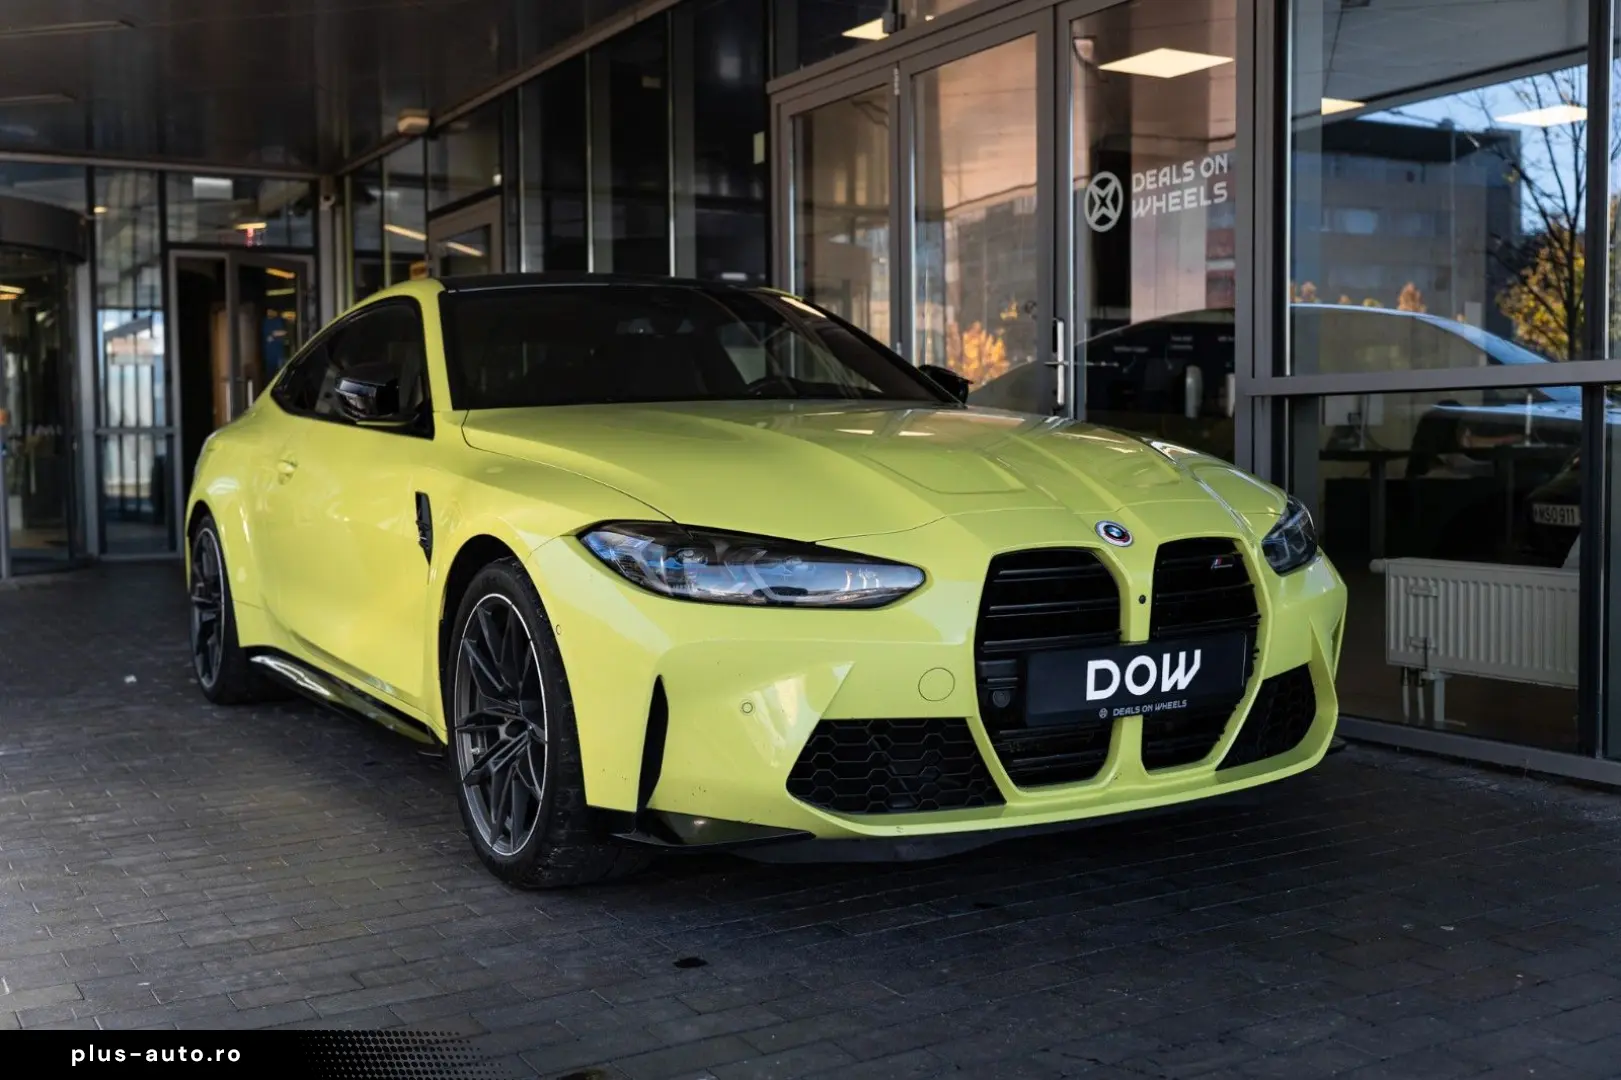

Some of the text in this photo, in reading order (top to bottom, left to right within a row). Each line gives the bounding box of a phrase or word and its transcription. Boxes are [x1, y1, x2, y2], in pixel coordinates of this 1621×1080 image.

[1131, 153, 1228, 193] DEALS ON
[1131, 181, 1228, 219] WHEELS
[1086, 649, 1202, 701] DOW
[1112, 699, 1188, 717] DEALS ON WHEELS
